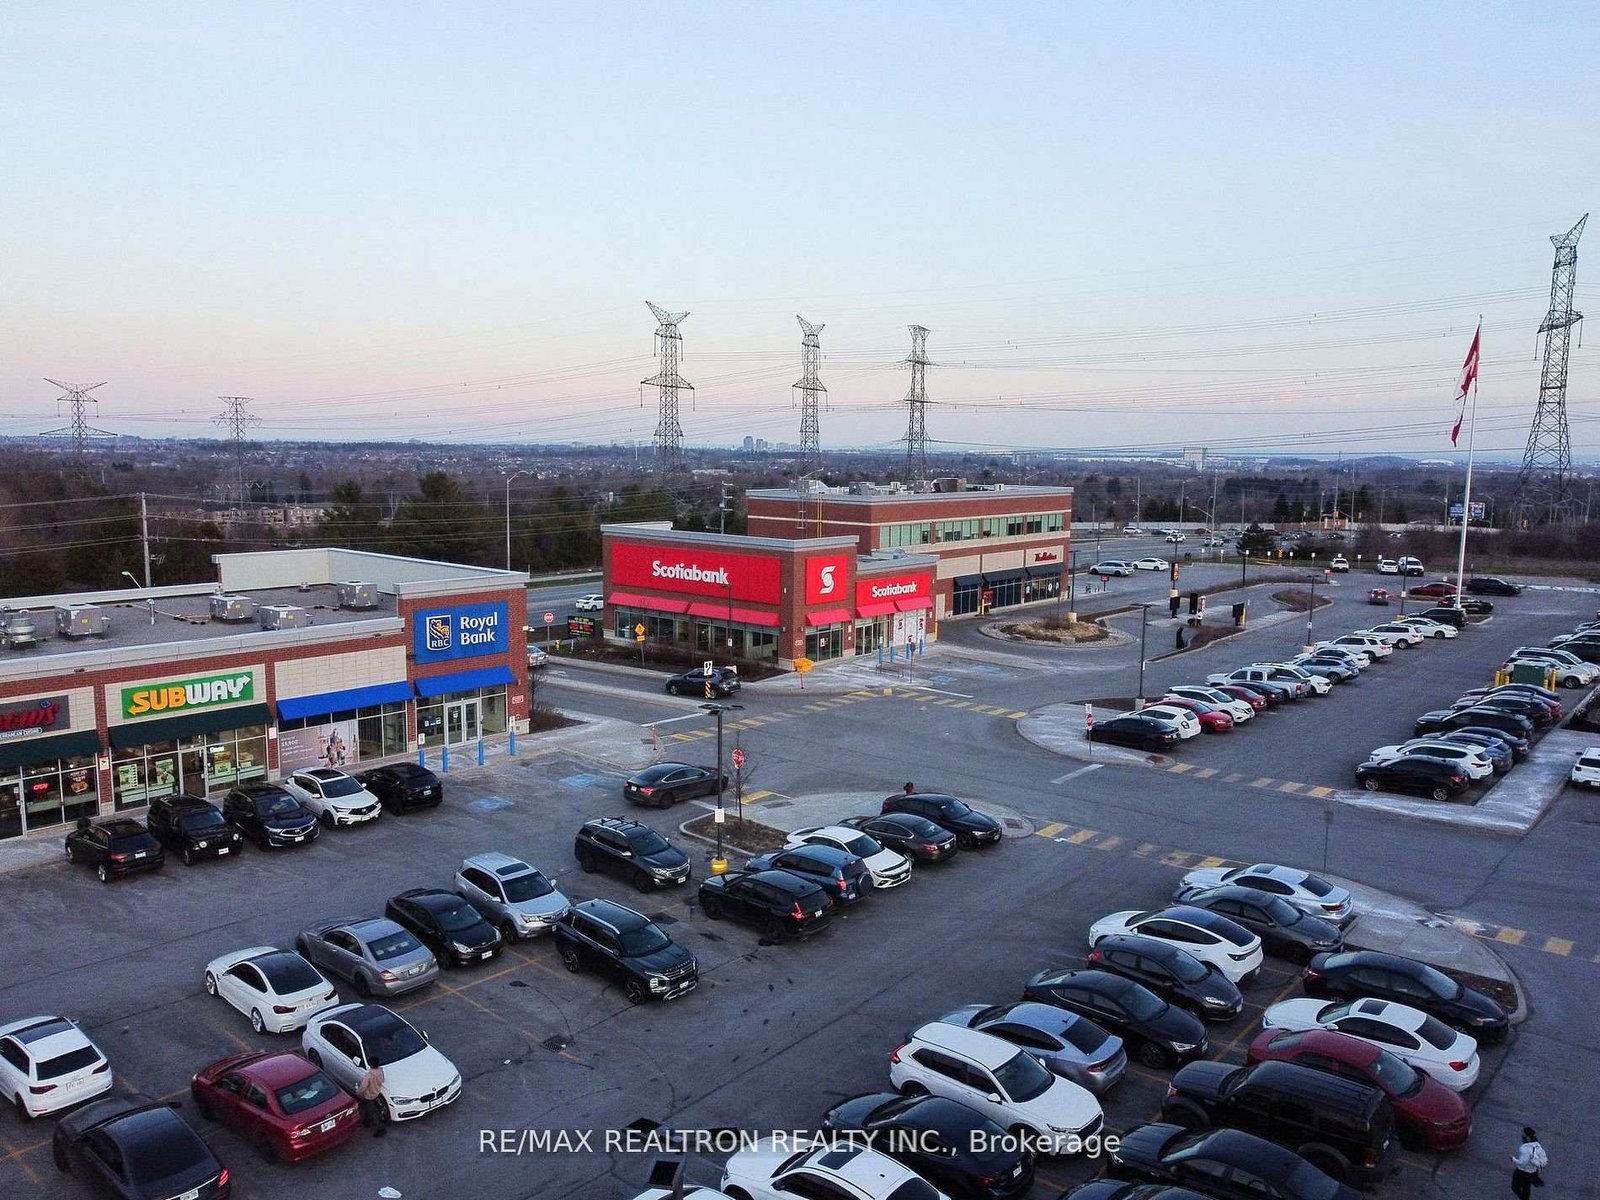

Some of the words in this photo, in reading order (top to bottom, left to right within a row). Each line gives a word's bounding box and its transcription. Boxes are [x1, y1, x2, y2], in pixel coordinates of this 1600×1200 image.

[652, 560, 729, 585] Scotiabank
[872, 581, 917, 598] Scotiabank
[460, 611, 498, 632] Royal
[431, 638, 449, 648] RBC
[460, 628, 496, 645] Bank
[128, 675, 251, 715] SUBWAY
